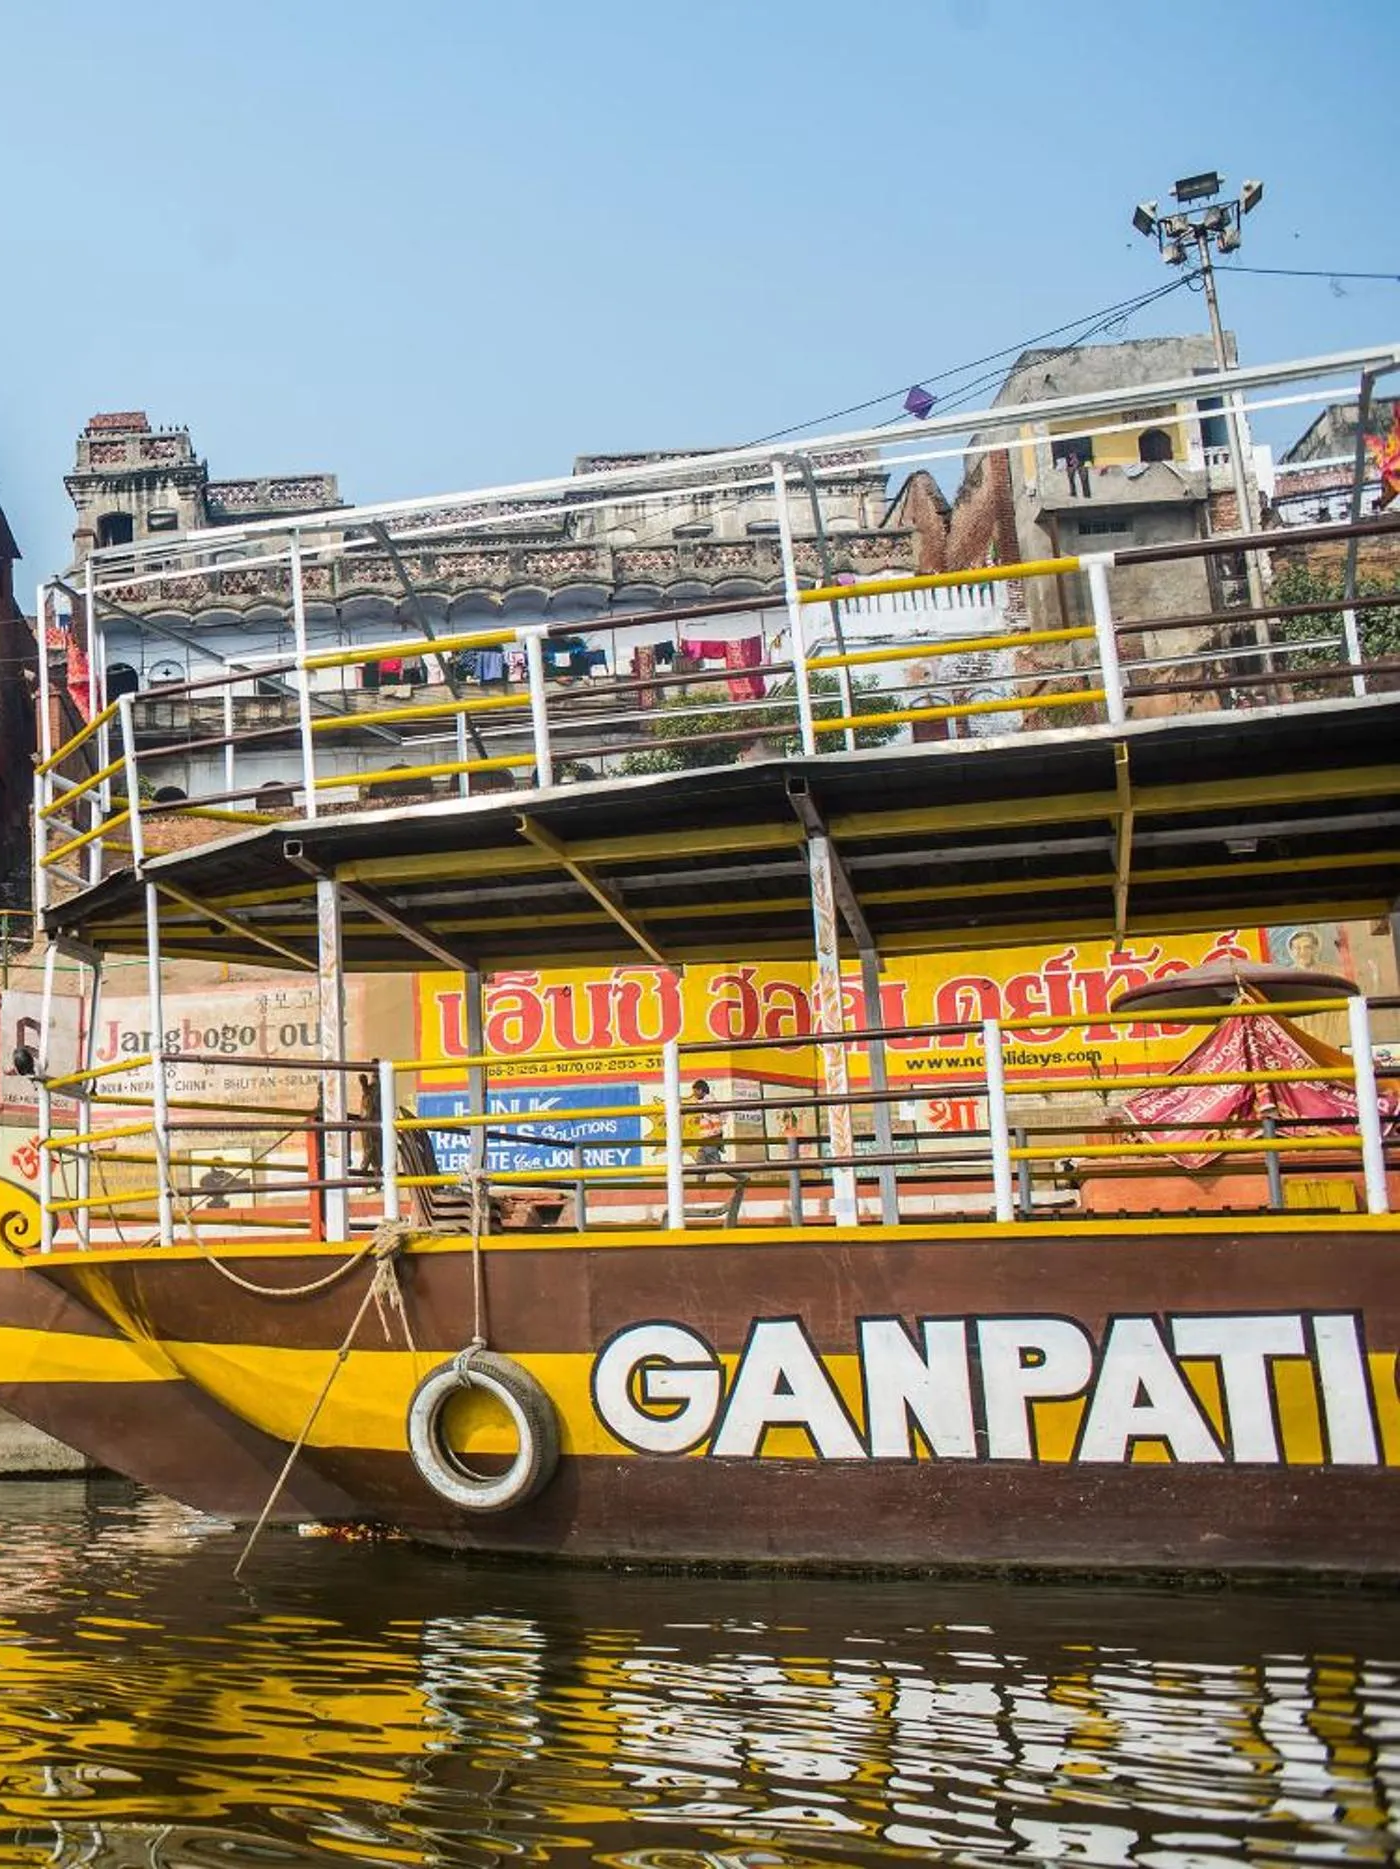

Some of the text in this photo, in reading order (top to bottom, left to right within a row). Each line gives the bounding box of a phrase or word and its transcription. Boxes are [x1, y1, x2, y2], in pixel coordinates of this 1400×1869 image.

[906, 1048, 1102, 1069] www.ncolidays.com
[428, 1122, 539, 1149] TRAELS
[590, 1309, 1385, 1465] GANPATI
